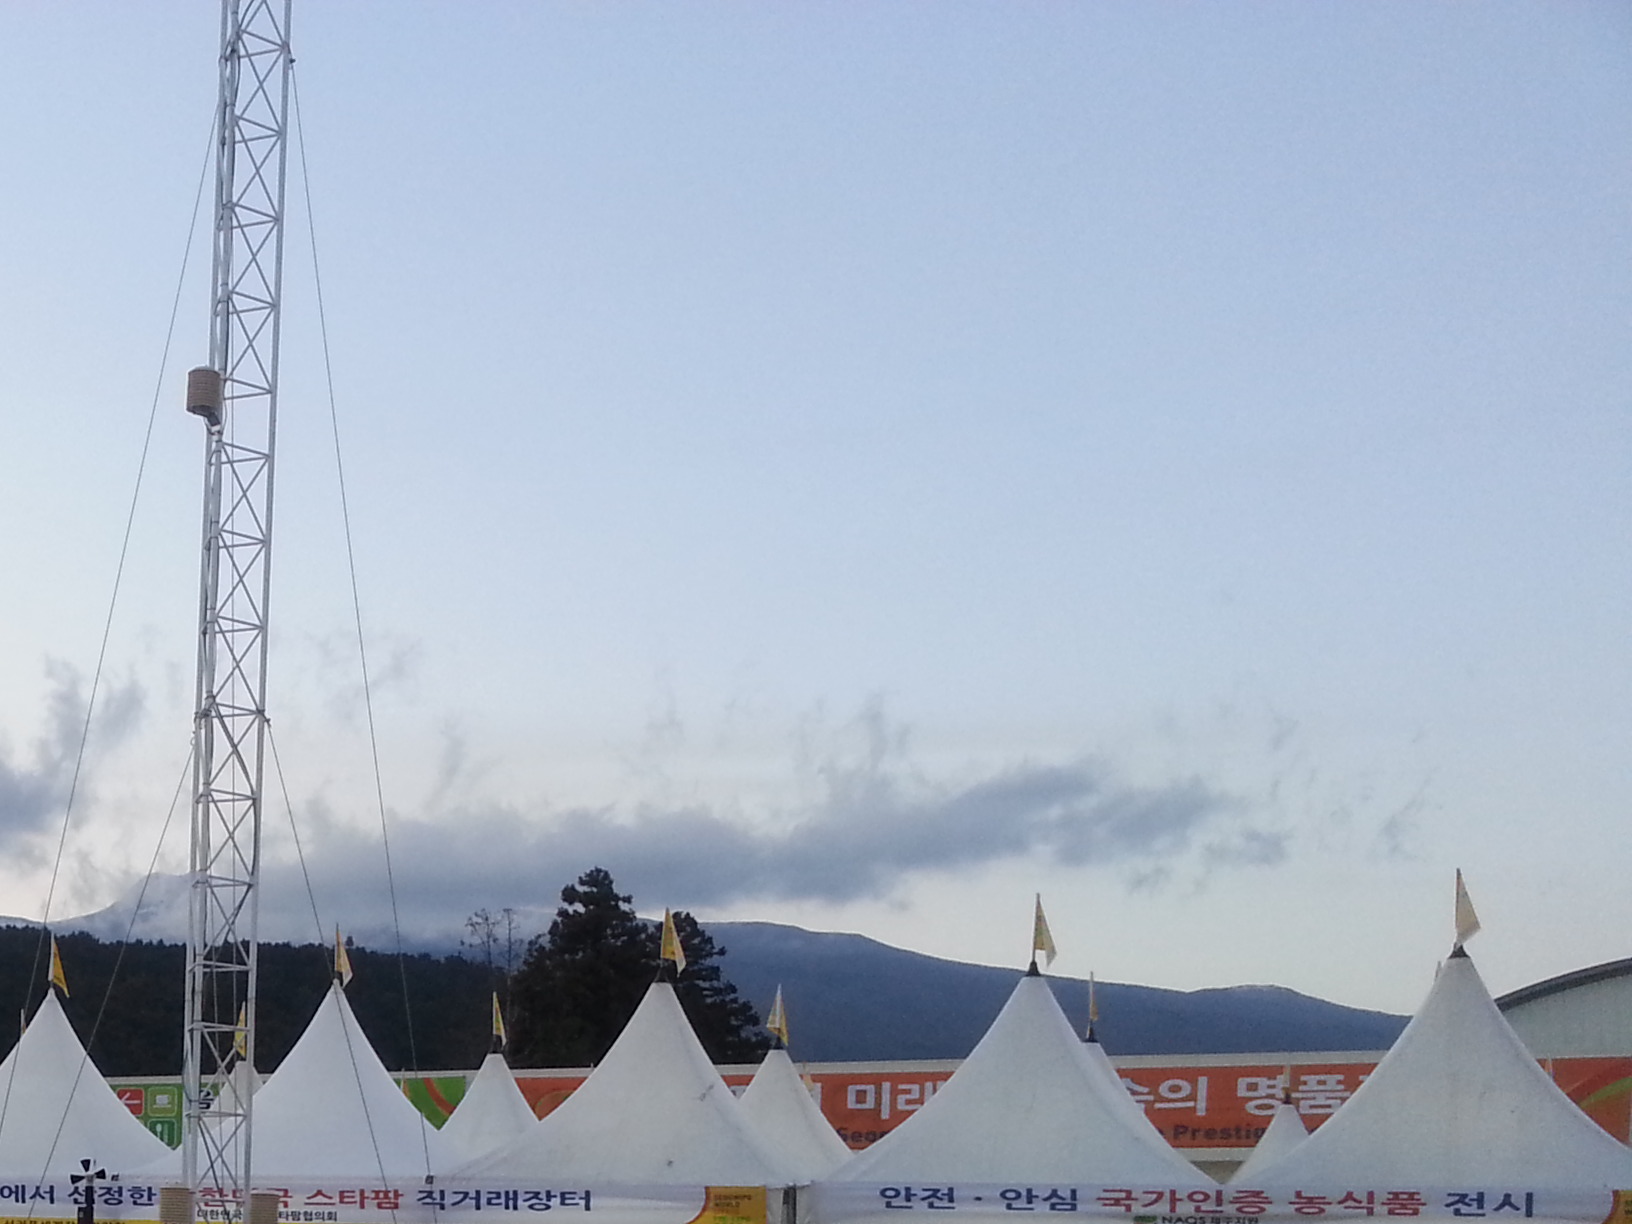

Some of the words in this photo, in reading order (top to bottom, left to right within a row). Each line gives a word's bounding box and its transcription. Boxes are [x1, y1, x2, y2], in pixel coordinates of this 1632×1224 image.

[304, 1188, 404, 1210] 스타팜
[417, 1189, 591, 1212] 직거래장터
[879, 1186, 956, 1210] 안전
[999, 1187, 1078, 1212] 안심
[1096, 1188, 1273, 1215] 국가인증
[1288, 1190, 1427, 1217] 농식품
[1444, 1191, 1533, 1218] 전시
